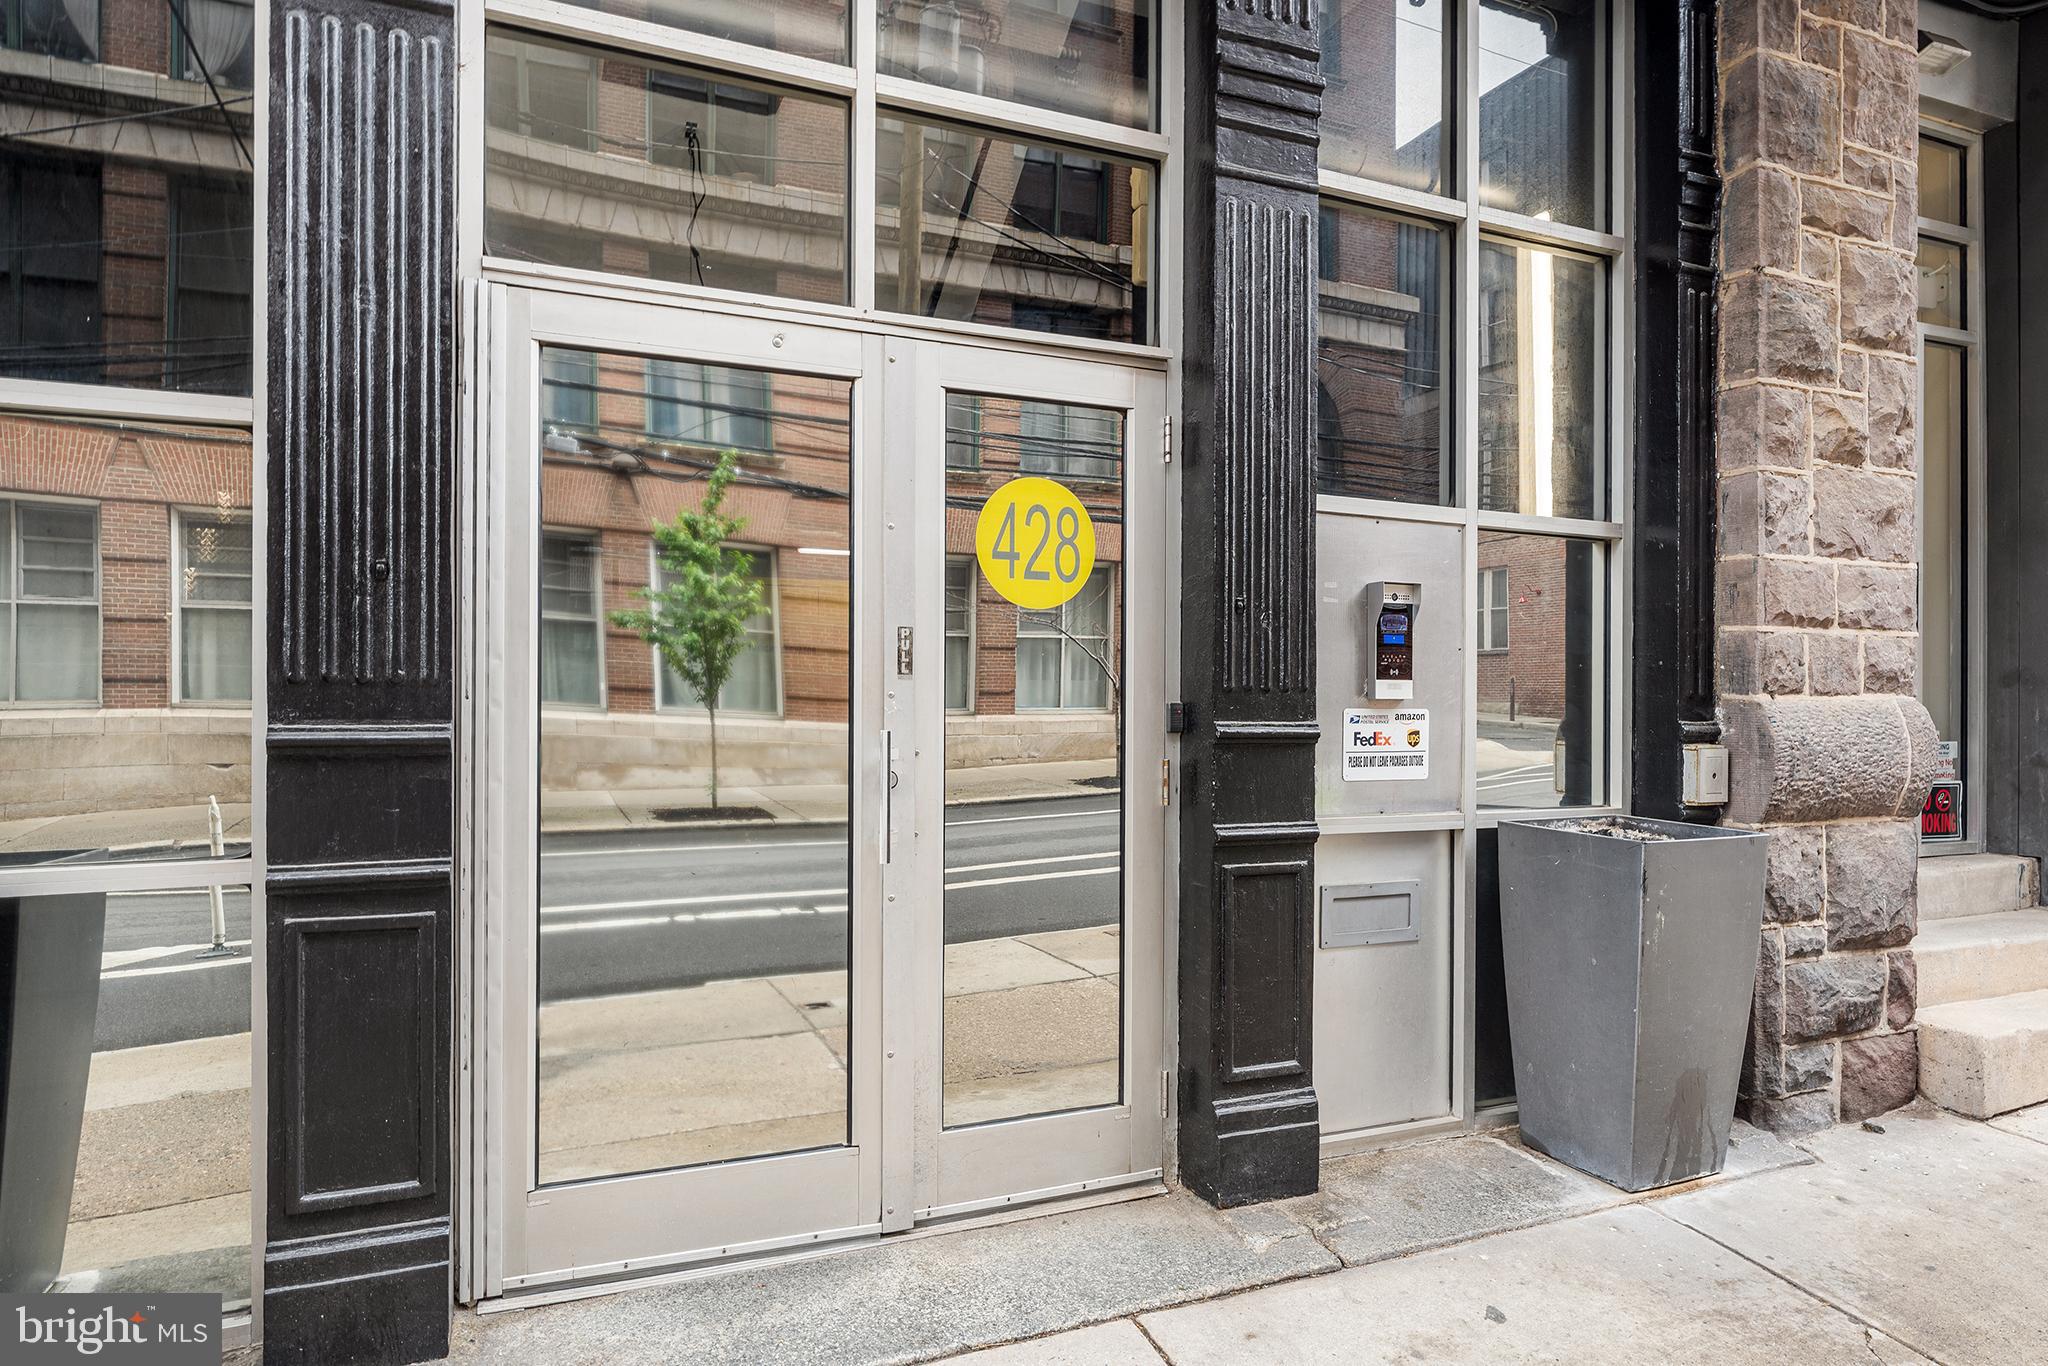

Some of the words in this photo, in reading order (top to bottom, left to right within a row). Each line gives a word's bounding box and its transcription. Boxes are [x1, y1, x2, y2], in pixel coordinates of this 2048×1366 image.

[991, 501, 1081, 584] 428
[900, 627, 911, 674] PULL
[1353, 731, 1391, 746] FedEx
[1348, 755, 1363, 768] PLEASE
[1363, 755, 1369, 768] DO
[1377, 755, 1389, 768] LEAVE
[1389, 755, 1408, 767] PACKAGES
[1409, 755, 1424, 766] OUTSIDE
